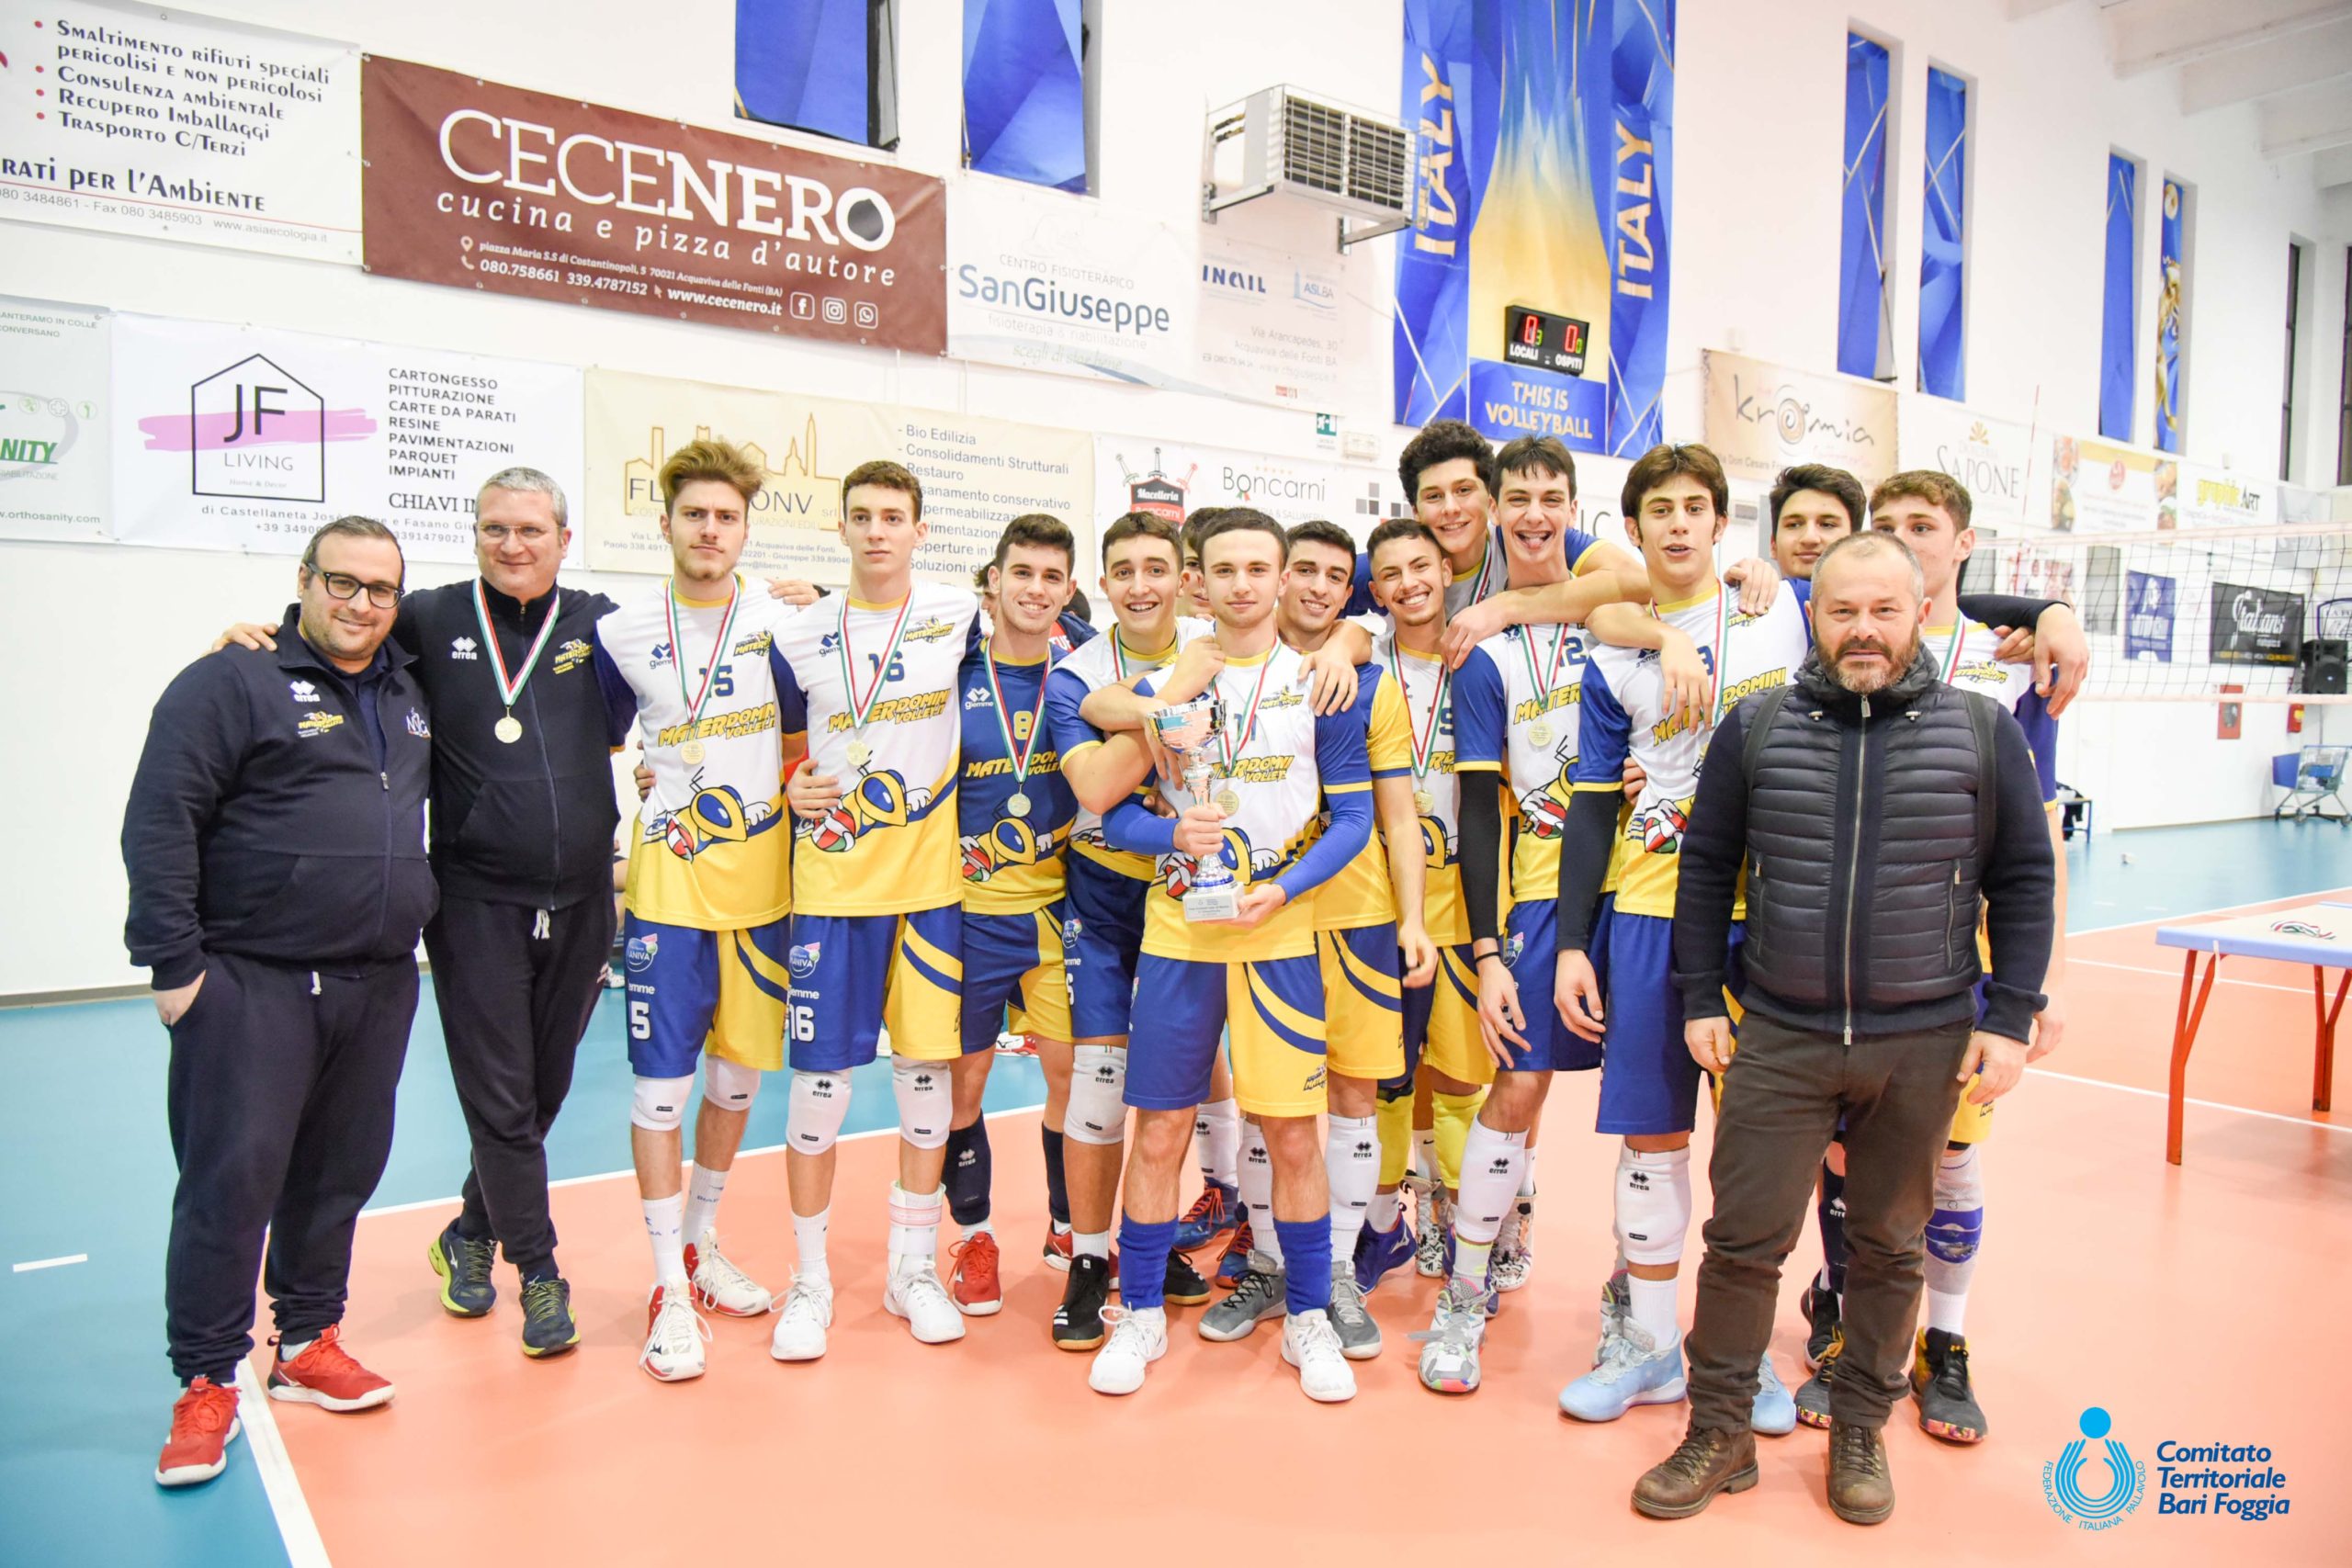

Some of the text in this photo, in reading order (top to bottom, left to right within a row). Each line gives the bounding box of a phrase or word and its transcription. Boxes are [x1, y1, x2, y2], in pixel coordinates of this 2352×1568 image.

[1415, 52, 1456, 258] ITALY
[439, 108, 897, 253] CECENERO
[23, 191, 328, 243] 3484861 Fax 080 3485903 www.asiaecologia.it
[1617, 119, 1654, 300] ITALY
[436, 191, 897, 288] cucina e pizza d'autore
[479, 241, 511, 256] piazza
[511, 245, 542, 261] Maria
[559, 253, 570, 265] di
[570, 254, 639, 276] Costantinopoli,
[650, 266, 675, 280] 70021
[676, 270, 720, 288] Acquaviva
[721, 277, 742, 290] delle
[742, 281, 764, 295] Fonti
[999, 254, 1135, 290] CENTRO FISIOTERAPICO
[479, 258, 783, 317] 080.758661 339.4787152 www.cecenero.it
[958, 264, 1170, 334] SanGiuseppe
[67, 318, 97, 330] COLLE
[988, 314, 1054, 337] fisioterapia
[1069, 327, 1147, 350] riabilitazione
[1510, 344, 1582, 371] LOCALI OSPITI
[389, 367, 499, 390] CARTONGESSO
[389, 384, 496, 406] PITTURAZIONE
[1512, 381, 1568, 410] THIS IS
[223, 383, 288, 444] JF
[389, 400, 517, 423] CARTE DA PARATI
[389, 417, 441, 432] RESINE
[1485, 401, 1593, 439] VOLLEYBALL
[389, 434, 514, 454] PAVIMENTAZIONI
[906, 424, 977, 446] Bio Edilizia
[223, 451, 294, 472] LIVING
[389, 449, 458, 466] PARQUET
[906, 443, 1069, 475] Consolidamenti Strutturali
[389, 465, 456, 480] IMPIANTI
[906, 462, 964, 481] Restauro
[1223, 467, 1325, 502] Boncarni
[389, 492, 457, 513] CHIAVI
[993, 492, 1070, 510] conservativo
[201, 504, 215, 515] di
[220, 506, 307, 521] Castellaneta
[404, 518, 449, 530] Fasano
[255, 524, 278, 533] +39
[604, 540, 809, 563] Paolo Giuseppe
[755, 541, 835, 554] Acquaviva delle Fonti
[977, 547, 988, 555] in
[828, 688, 951, 733] MAERDOMINI
[965, 701, 993, 710] giemme
[1013, 711, 1033, 740] 8
[789, 1006, 814, 1042] 16
[1829, 1208, 1846, 1218] erre
